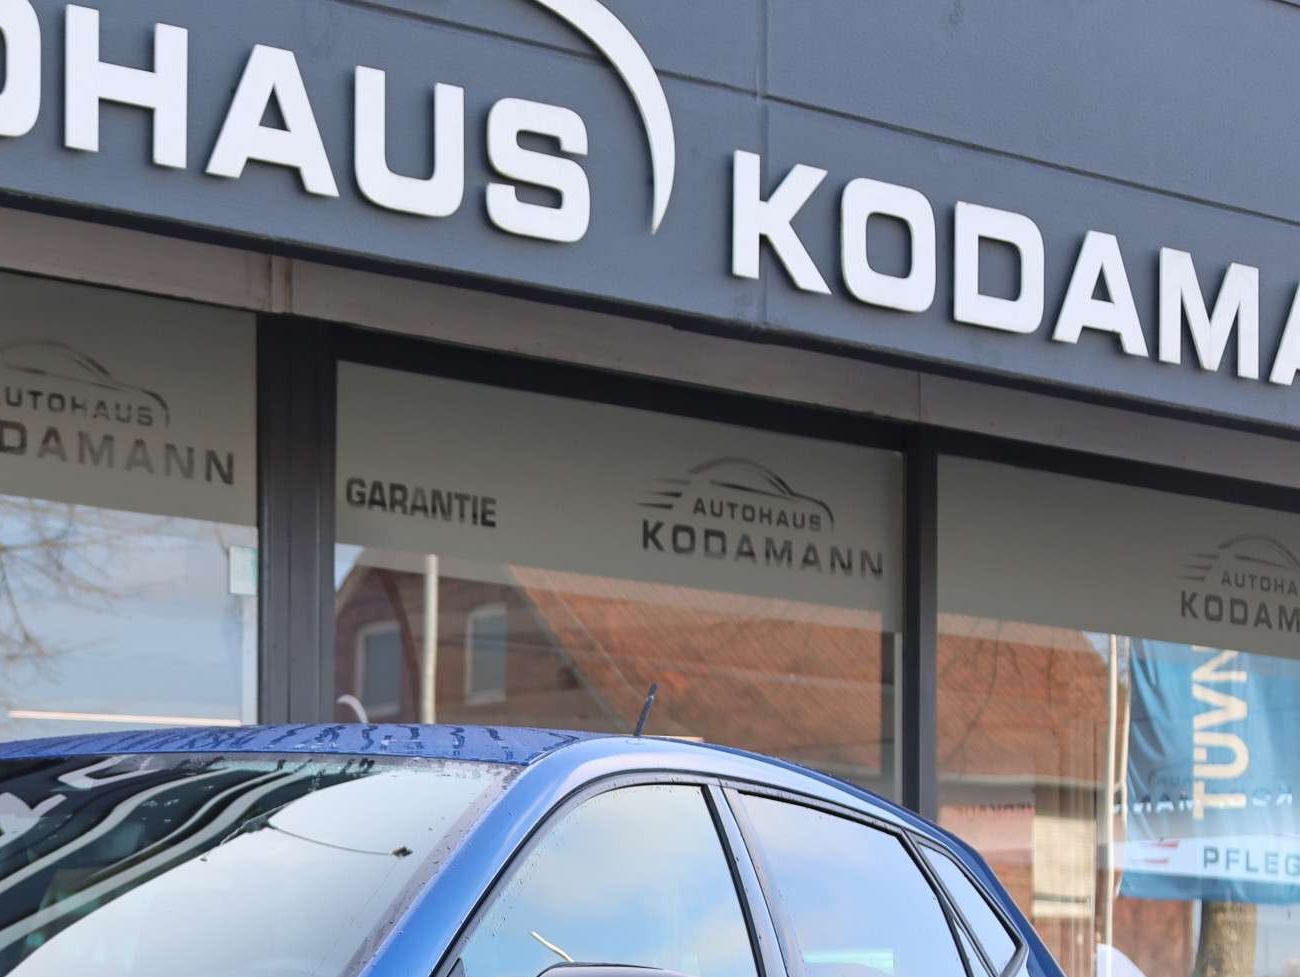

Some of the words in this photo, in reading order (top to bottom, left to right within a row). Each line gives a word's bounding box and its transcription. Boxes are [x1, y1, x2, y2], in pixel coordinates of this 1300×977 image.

[345, 477, 498, 529] GARANTIE
[692, 496, 823, 532] AUTOHAUS
[641, 519, 884, 581] KODAMANN
